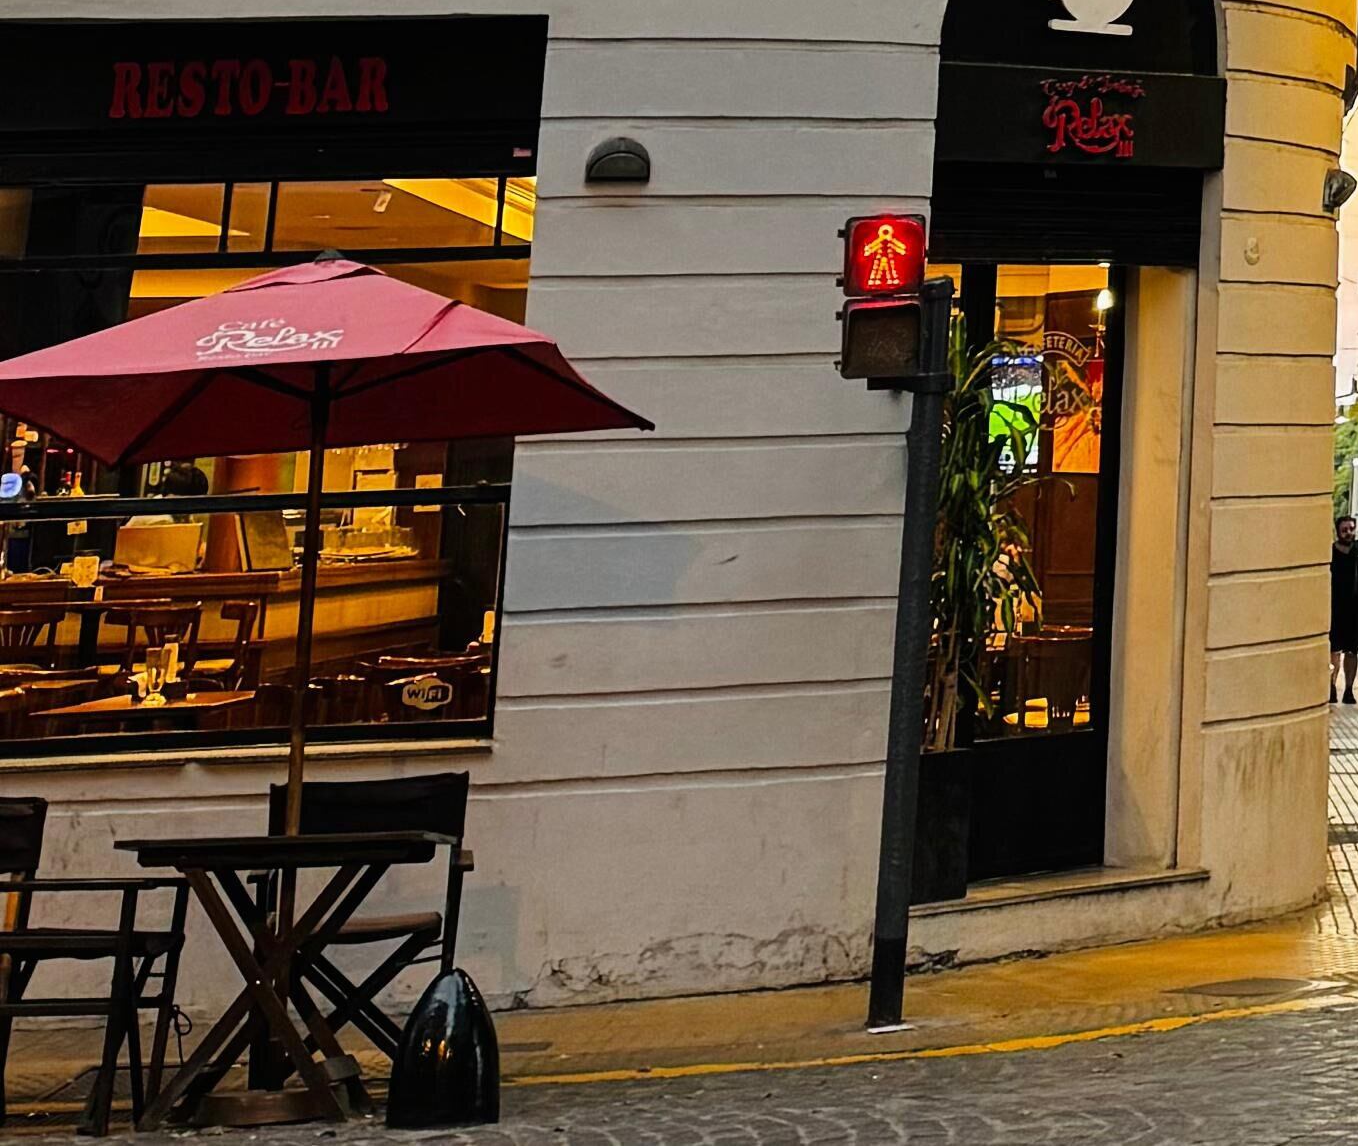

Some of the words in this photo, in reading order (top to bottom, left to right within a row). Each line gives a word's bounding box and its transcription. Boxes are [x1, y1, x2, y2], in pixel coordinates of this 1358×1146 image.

[109, 55, 389, 118] RESTO-BAR
[1042, 96, 1134, 153] Relax
[196, 327, 345, 355] Relax
